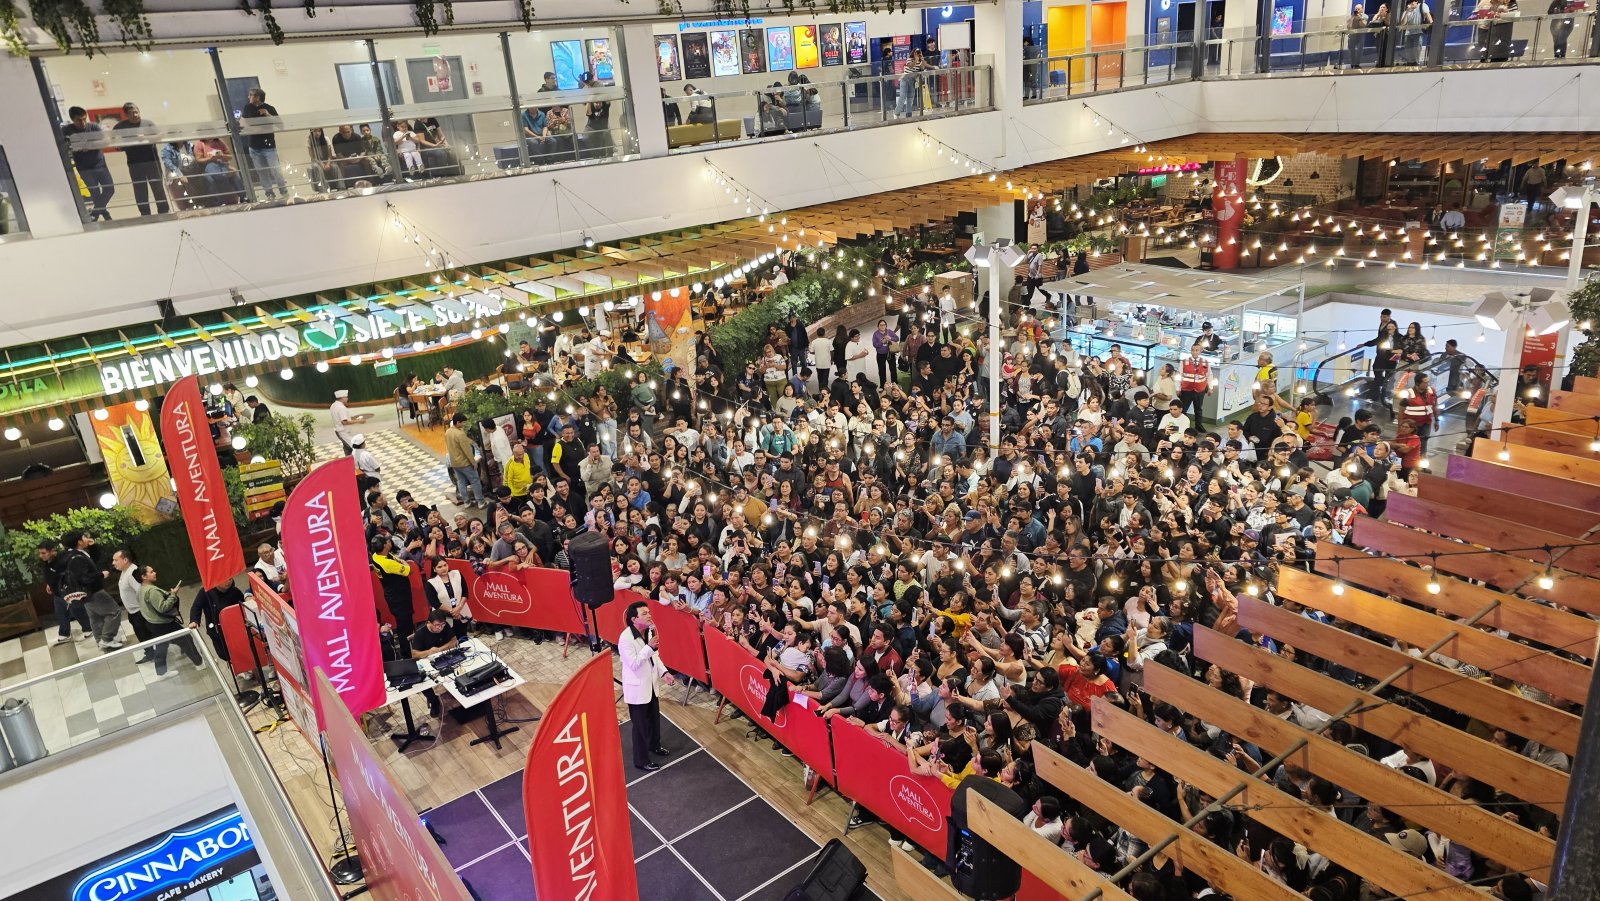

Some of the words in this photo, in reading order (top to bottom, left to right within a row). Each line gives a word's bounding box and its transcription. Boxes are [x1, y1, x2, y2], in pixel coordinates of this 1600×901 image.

[102, 331, 299, 395] BIENVENIDOS
[353, 308, 427, 343] SIETE
[172, 400, 209, 503] AVENTURA
[201, 508, 225, 562] MALL
[304, 490, 346, 621] AVENTURA
[483, 590, 523, 602] AVENTURA
[486, 582, 511, 593] MALL
[326, 628, 356, 695] MALL
[749, 674, 767, 696] MALL
[552, 713, 598, 901] VENTURA
[898, 791, 935, 820] AVENTURA
[901, 784, 923, 805] MALL
[156, 886, 182, 901] CAFE
[189, 867, 224, 889] BAKERY
